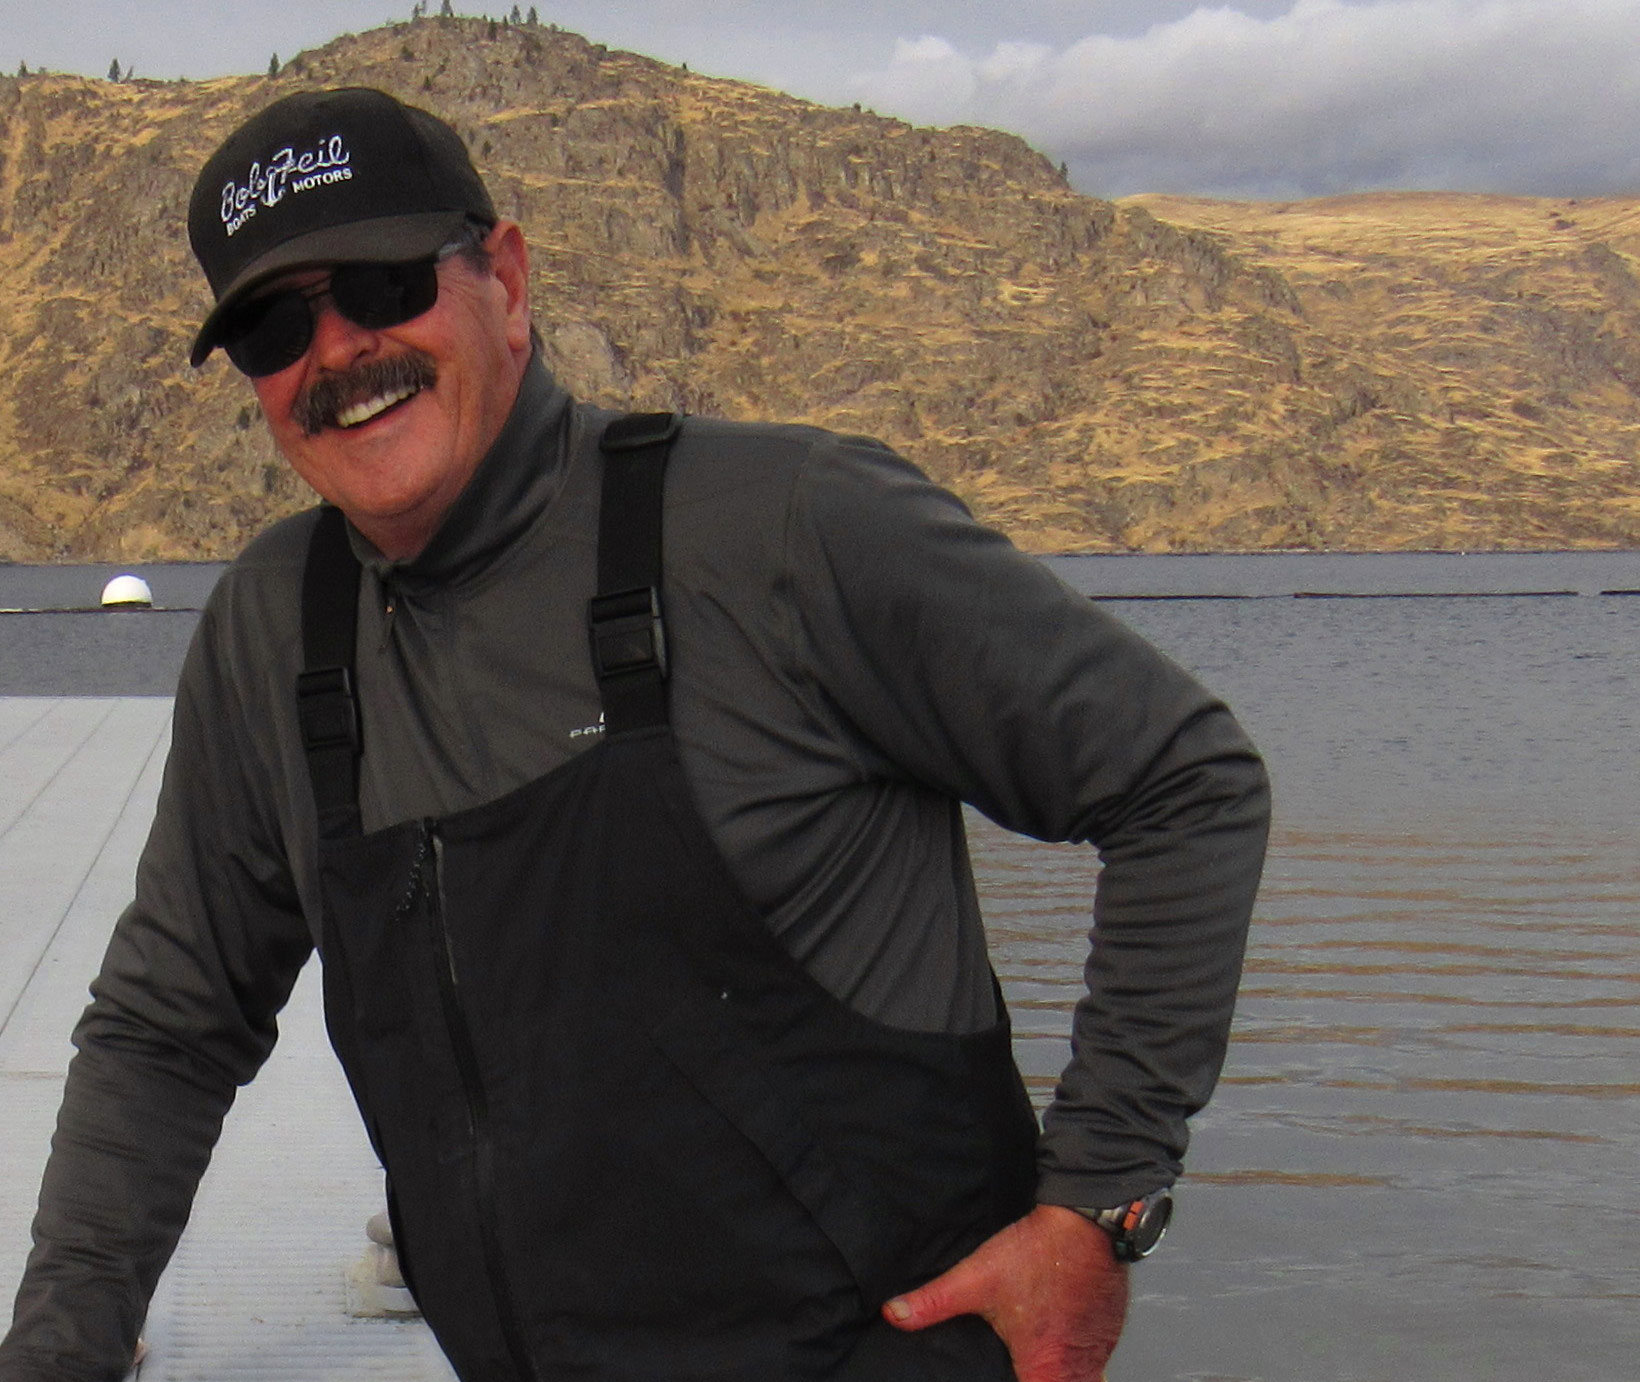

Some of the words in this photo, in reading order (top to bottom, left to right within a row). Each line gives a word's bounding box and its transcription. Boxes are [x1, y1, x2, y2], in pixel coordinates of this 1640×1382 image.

[221, 162, 267, 222] Bob
[271, 135, 350, 185] Feil
[225, 203, 257, 236] BOATS
[291, 167, 353, 193] MOTORS
